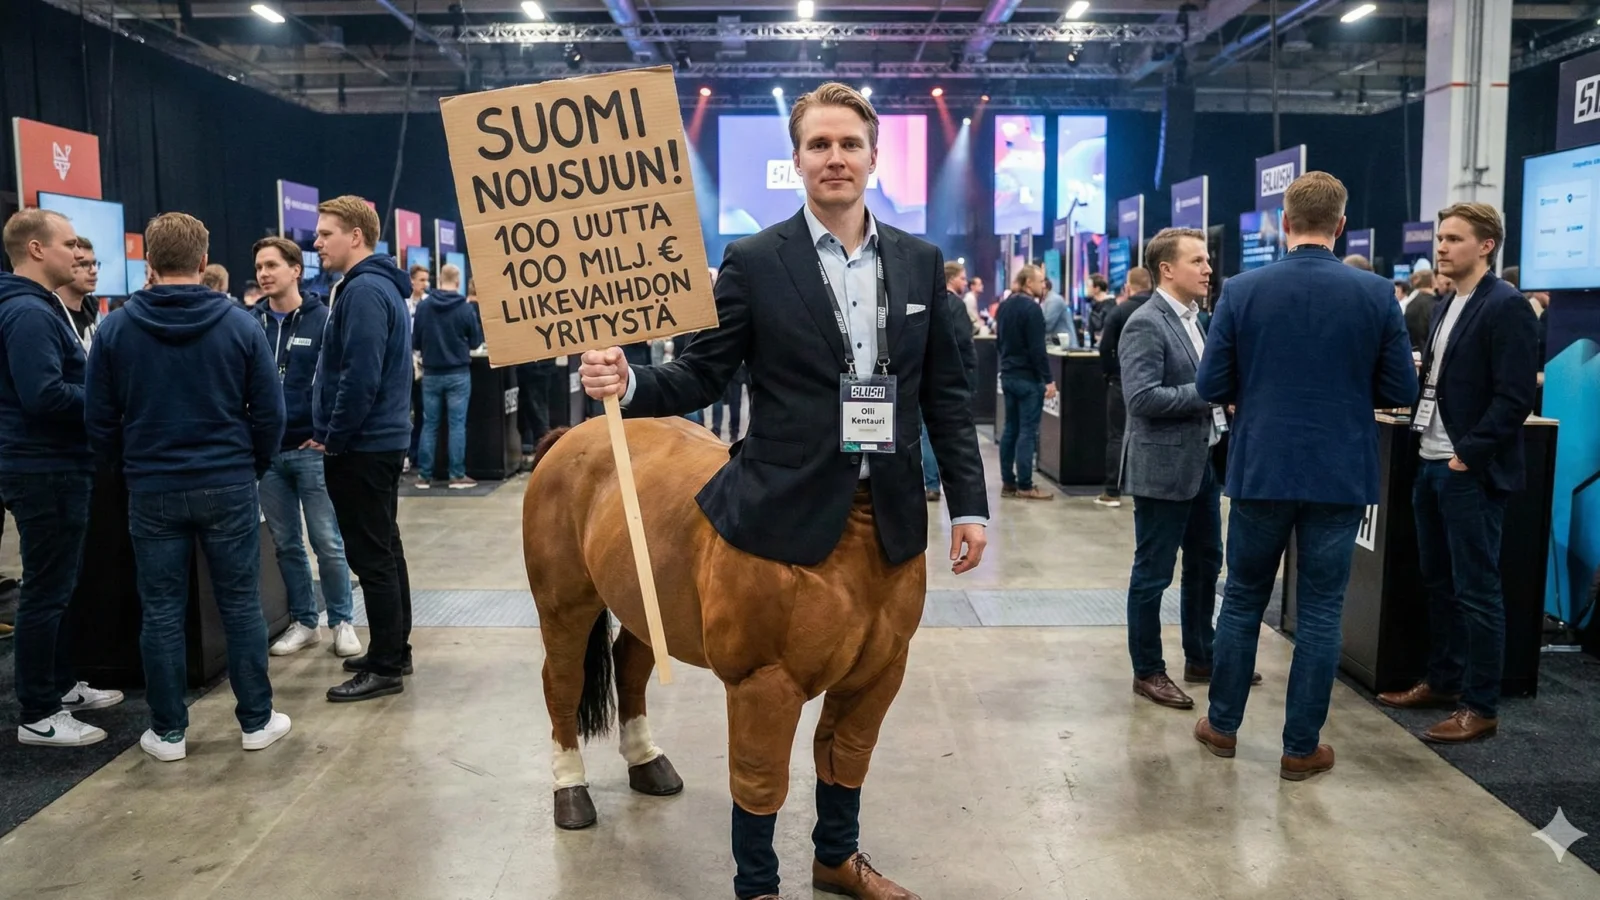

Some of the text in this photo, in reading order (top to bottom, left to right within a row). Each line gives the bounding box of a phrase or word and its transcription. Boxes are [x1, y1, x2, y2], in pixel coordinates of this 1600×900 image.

[476, 87, 646, 160] SUOMI
[472, 139, 682, 214] NOUSUUN!
[494, 218, 560, 256] 100
[573, 202, 672, 241] UUTTA
[502, 235, 683, 291] 100 MILJ. €
[501, 268, 692, 323] LIIKEVAIHDON
[535, 297, 678, 350] YRITYSTÄ
[852, 386, 884, 398] SLUSH
[861, 407, 875, 415] Olli
[851, 417, 885, 425] Kentauri
